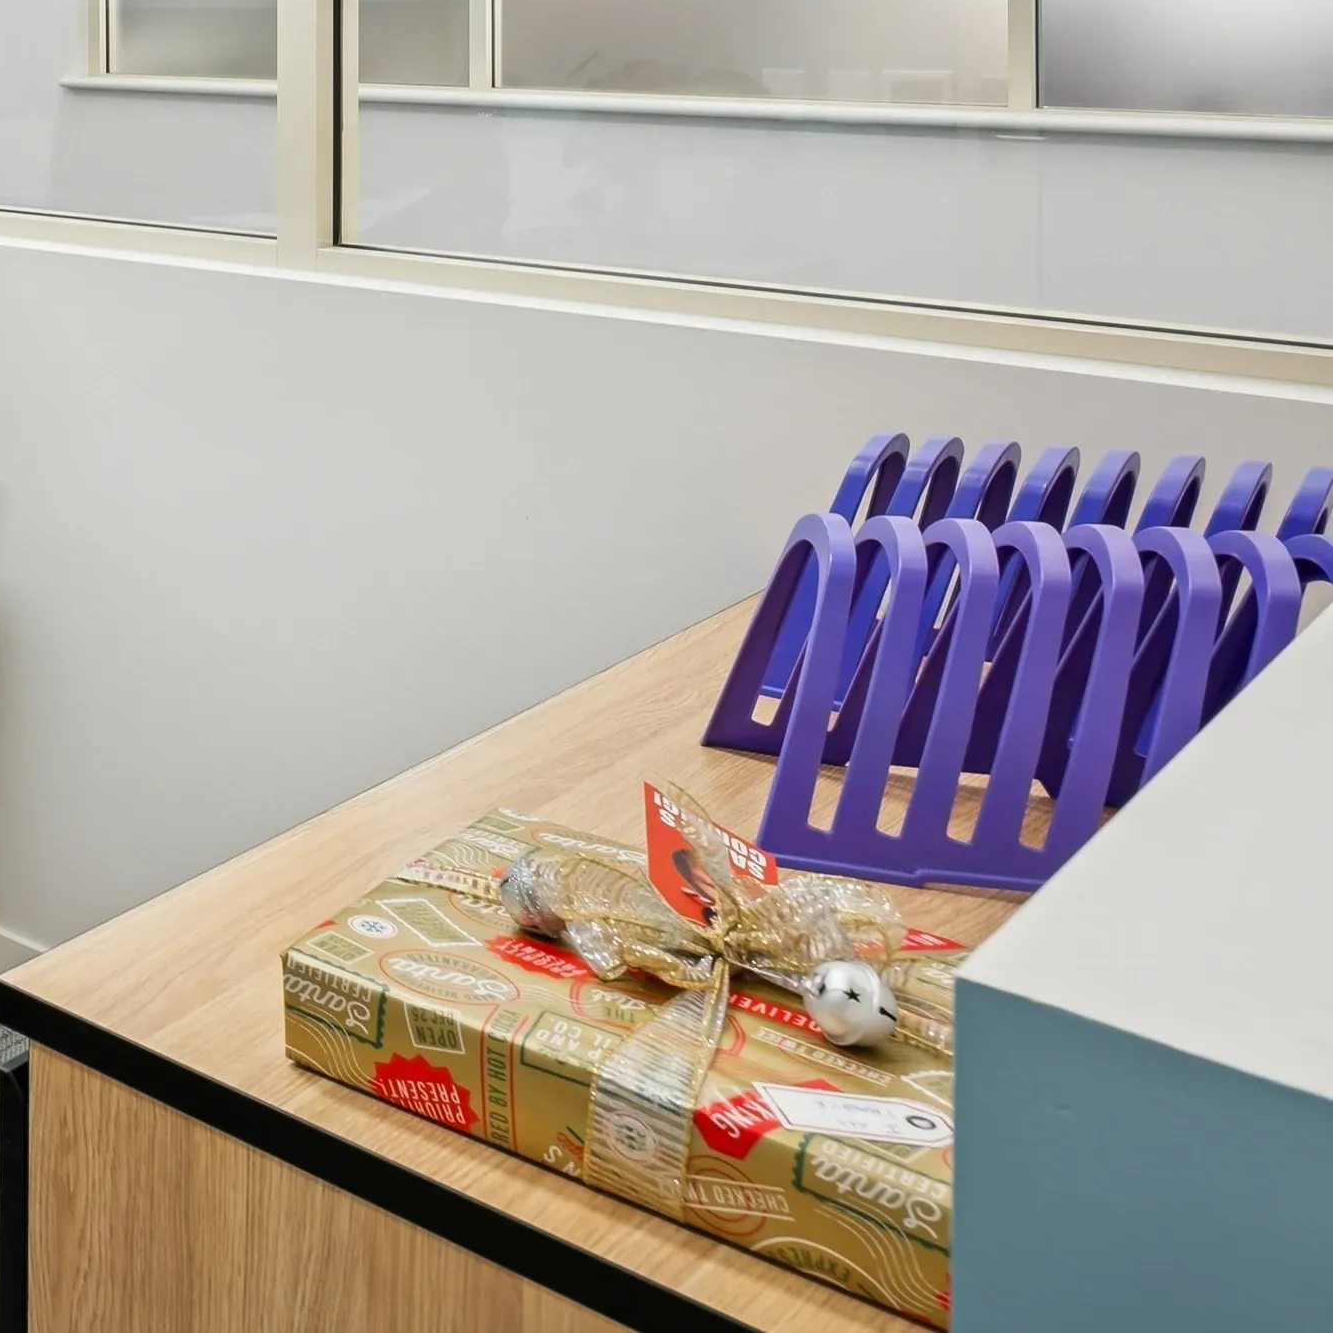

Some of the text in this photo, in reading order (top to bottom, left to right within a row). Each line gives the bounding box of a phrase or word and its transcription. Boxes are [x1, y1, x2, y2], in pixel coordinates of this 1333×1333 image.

[387, 956, 511, 1002] Santa
[284, 973, 371, 1035] Santa
[416, 1025, 459, 1049] OPEN
[536, 1028, 581, 1051] AND
[487, 1046, 508, 1080] HOT
[381, 1077, 461, 1104] PRESENT!
[488, 1085, 508, 1107] BY
[822, 1140, 949, 1200] CERTIFIED
[713, 1185, 790, 1214] CHECKED
[811, 1154, 942, 1240] Santa
